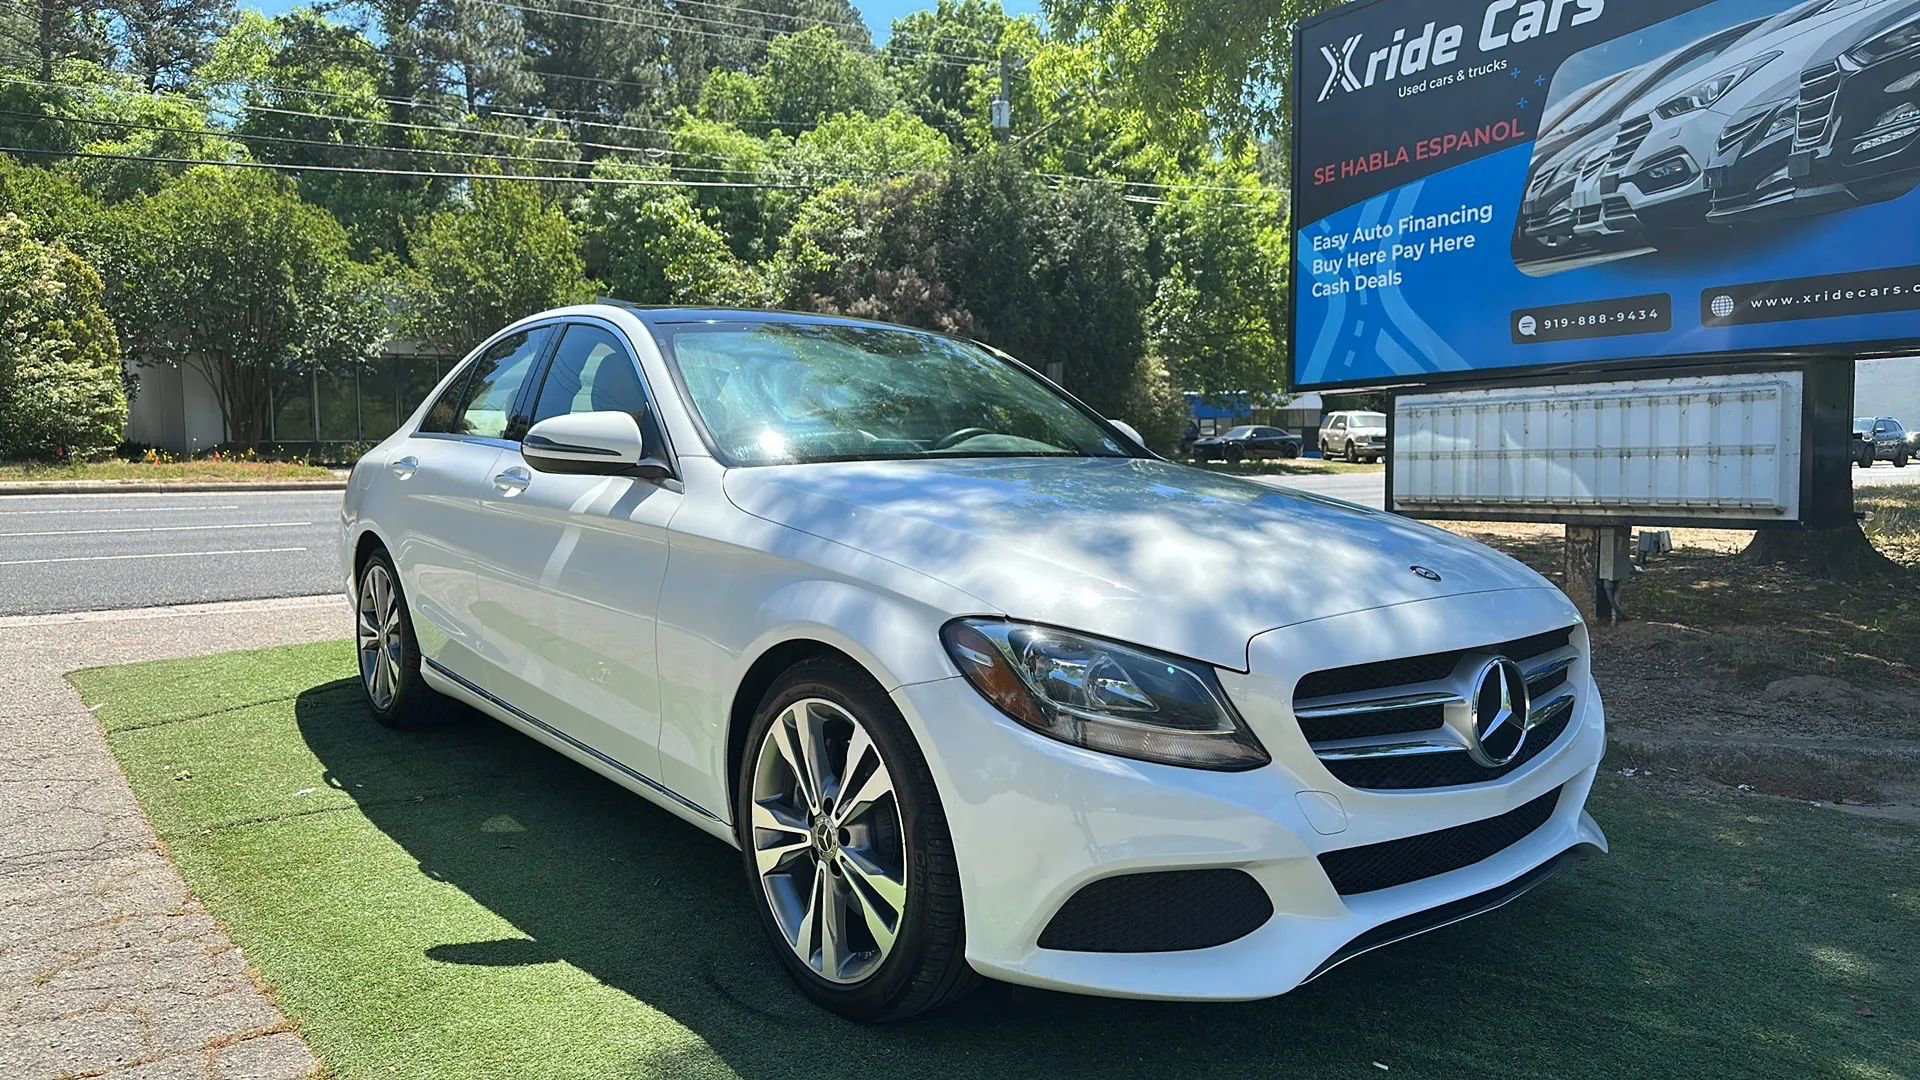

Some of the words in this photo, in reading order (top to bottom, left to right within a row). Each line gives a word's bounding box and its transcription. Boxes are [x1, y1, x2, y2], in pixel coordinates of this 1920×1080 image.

[1316, 21, 1464, 103] Xride
[1478, 0, 1605, 51] Cars
[1398, 83, 1427, 99] Used
[1429, 75, 1454, 89] cars
[1457, 70, 1465, 82] &
[1468, 59, 1508, 79] trucks
[1314, 164, 1335, 186] SE
[1341, 147, 1409, 179] HABLA
[1416, 118, 1525, 161] ESPANOL
[1313, 233, 1348, 252] Easy
[1352, 224, 1393, 244] Auto
[1398, 203, 1493, 235] Financing
[1312, 257, 1343, 276] Buy
[1347, 250, 1387, 269] Here
[1391, 242, 1425, 262] Pay
[1430, 234, 1476, 255] Here
[1312, 278, 1350, 298] Cash
[1355, 269, 1403, 291] Deals
[1544, 307, 1659, 330] 919-888-9434
